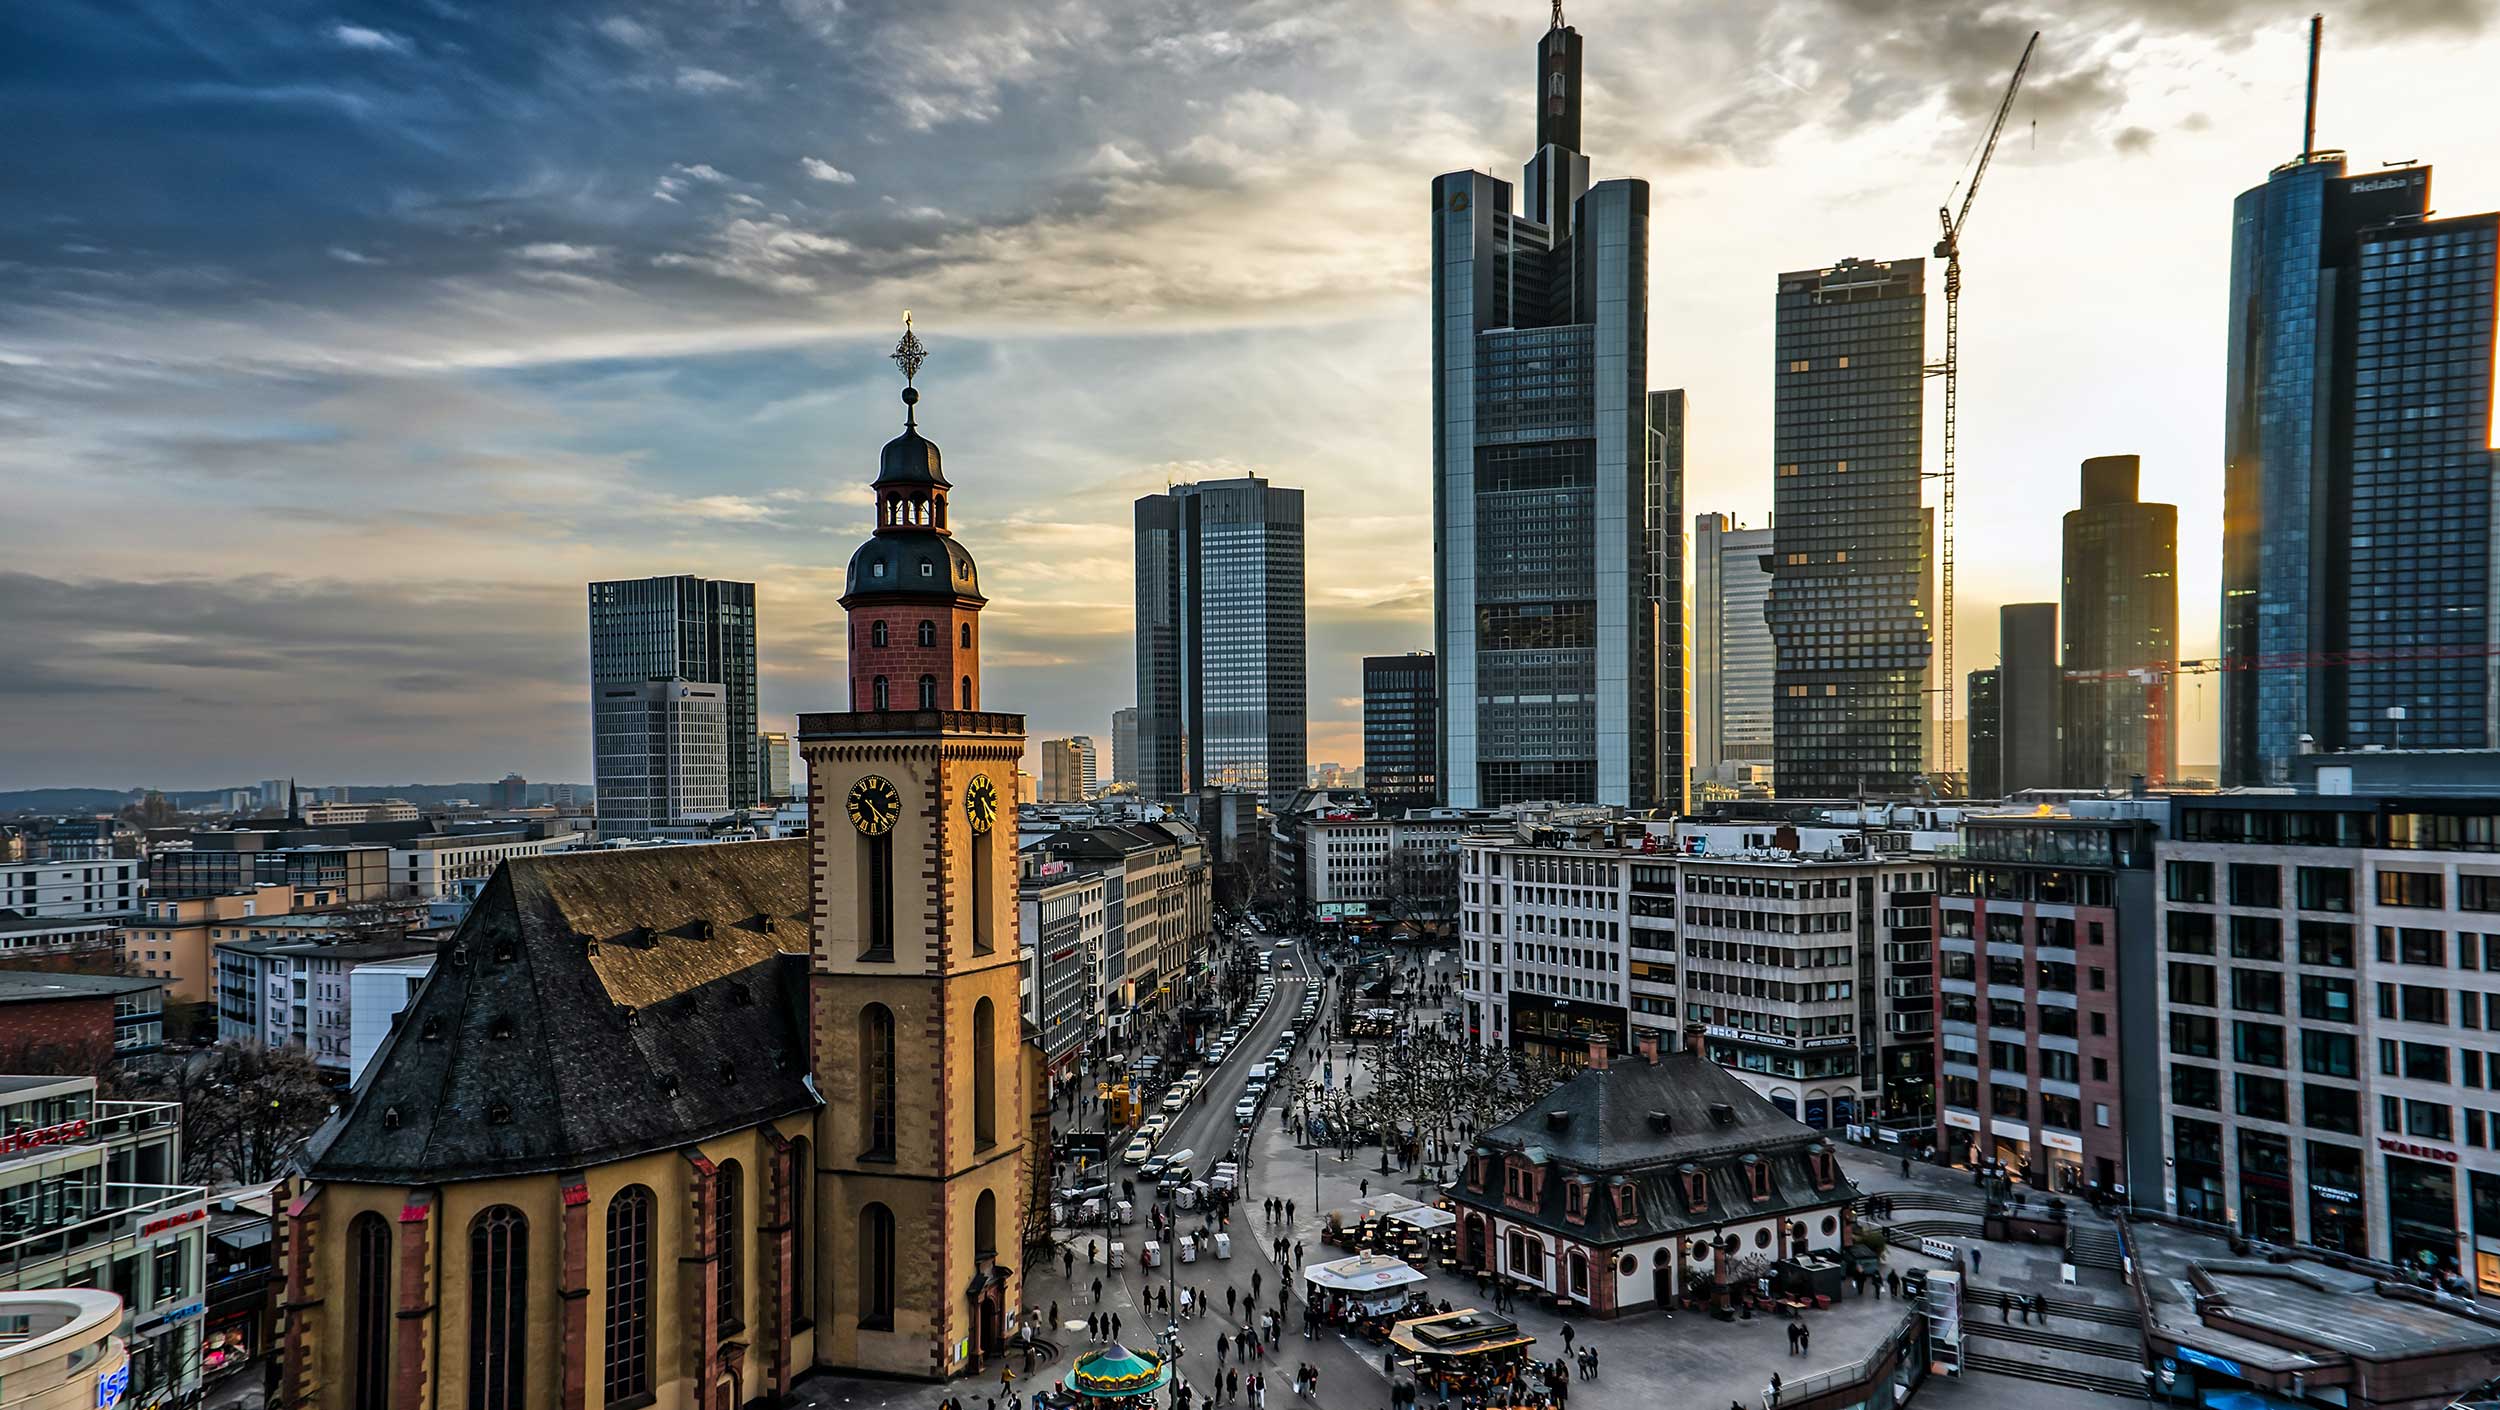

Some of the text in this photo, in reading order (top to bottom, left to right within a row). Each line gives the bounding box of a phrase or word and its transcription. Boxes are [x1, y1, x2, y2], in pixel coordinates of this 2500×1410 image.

[2351, 179, 2407, 193] Helaba
[1748, 846, 1769, 857] Your
[1770, 847, 1792, 861] Way
[1088, 943, 1096, 996] HOTEL
[2378, 1138, 2458, 1163] MAREDO
[2312, 1185, 2358, 1199] STARBUCKS
[2320, 1192, 2350, 1203] COFFEE
